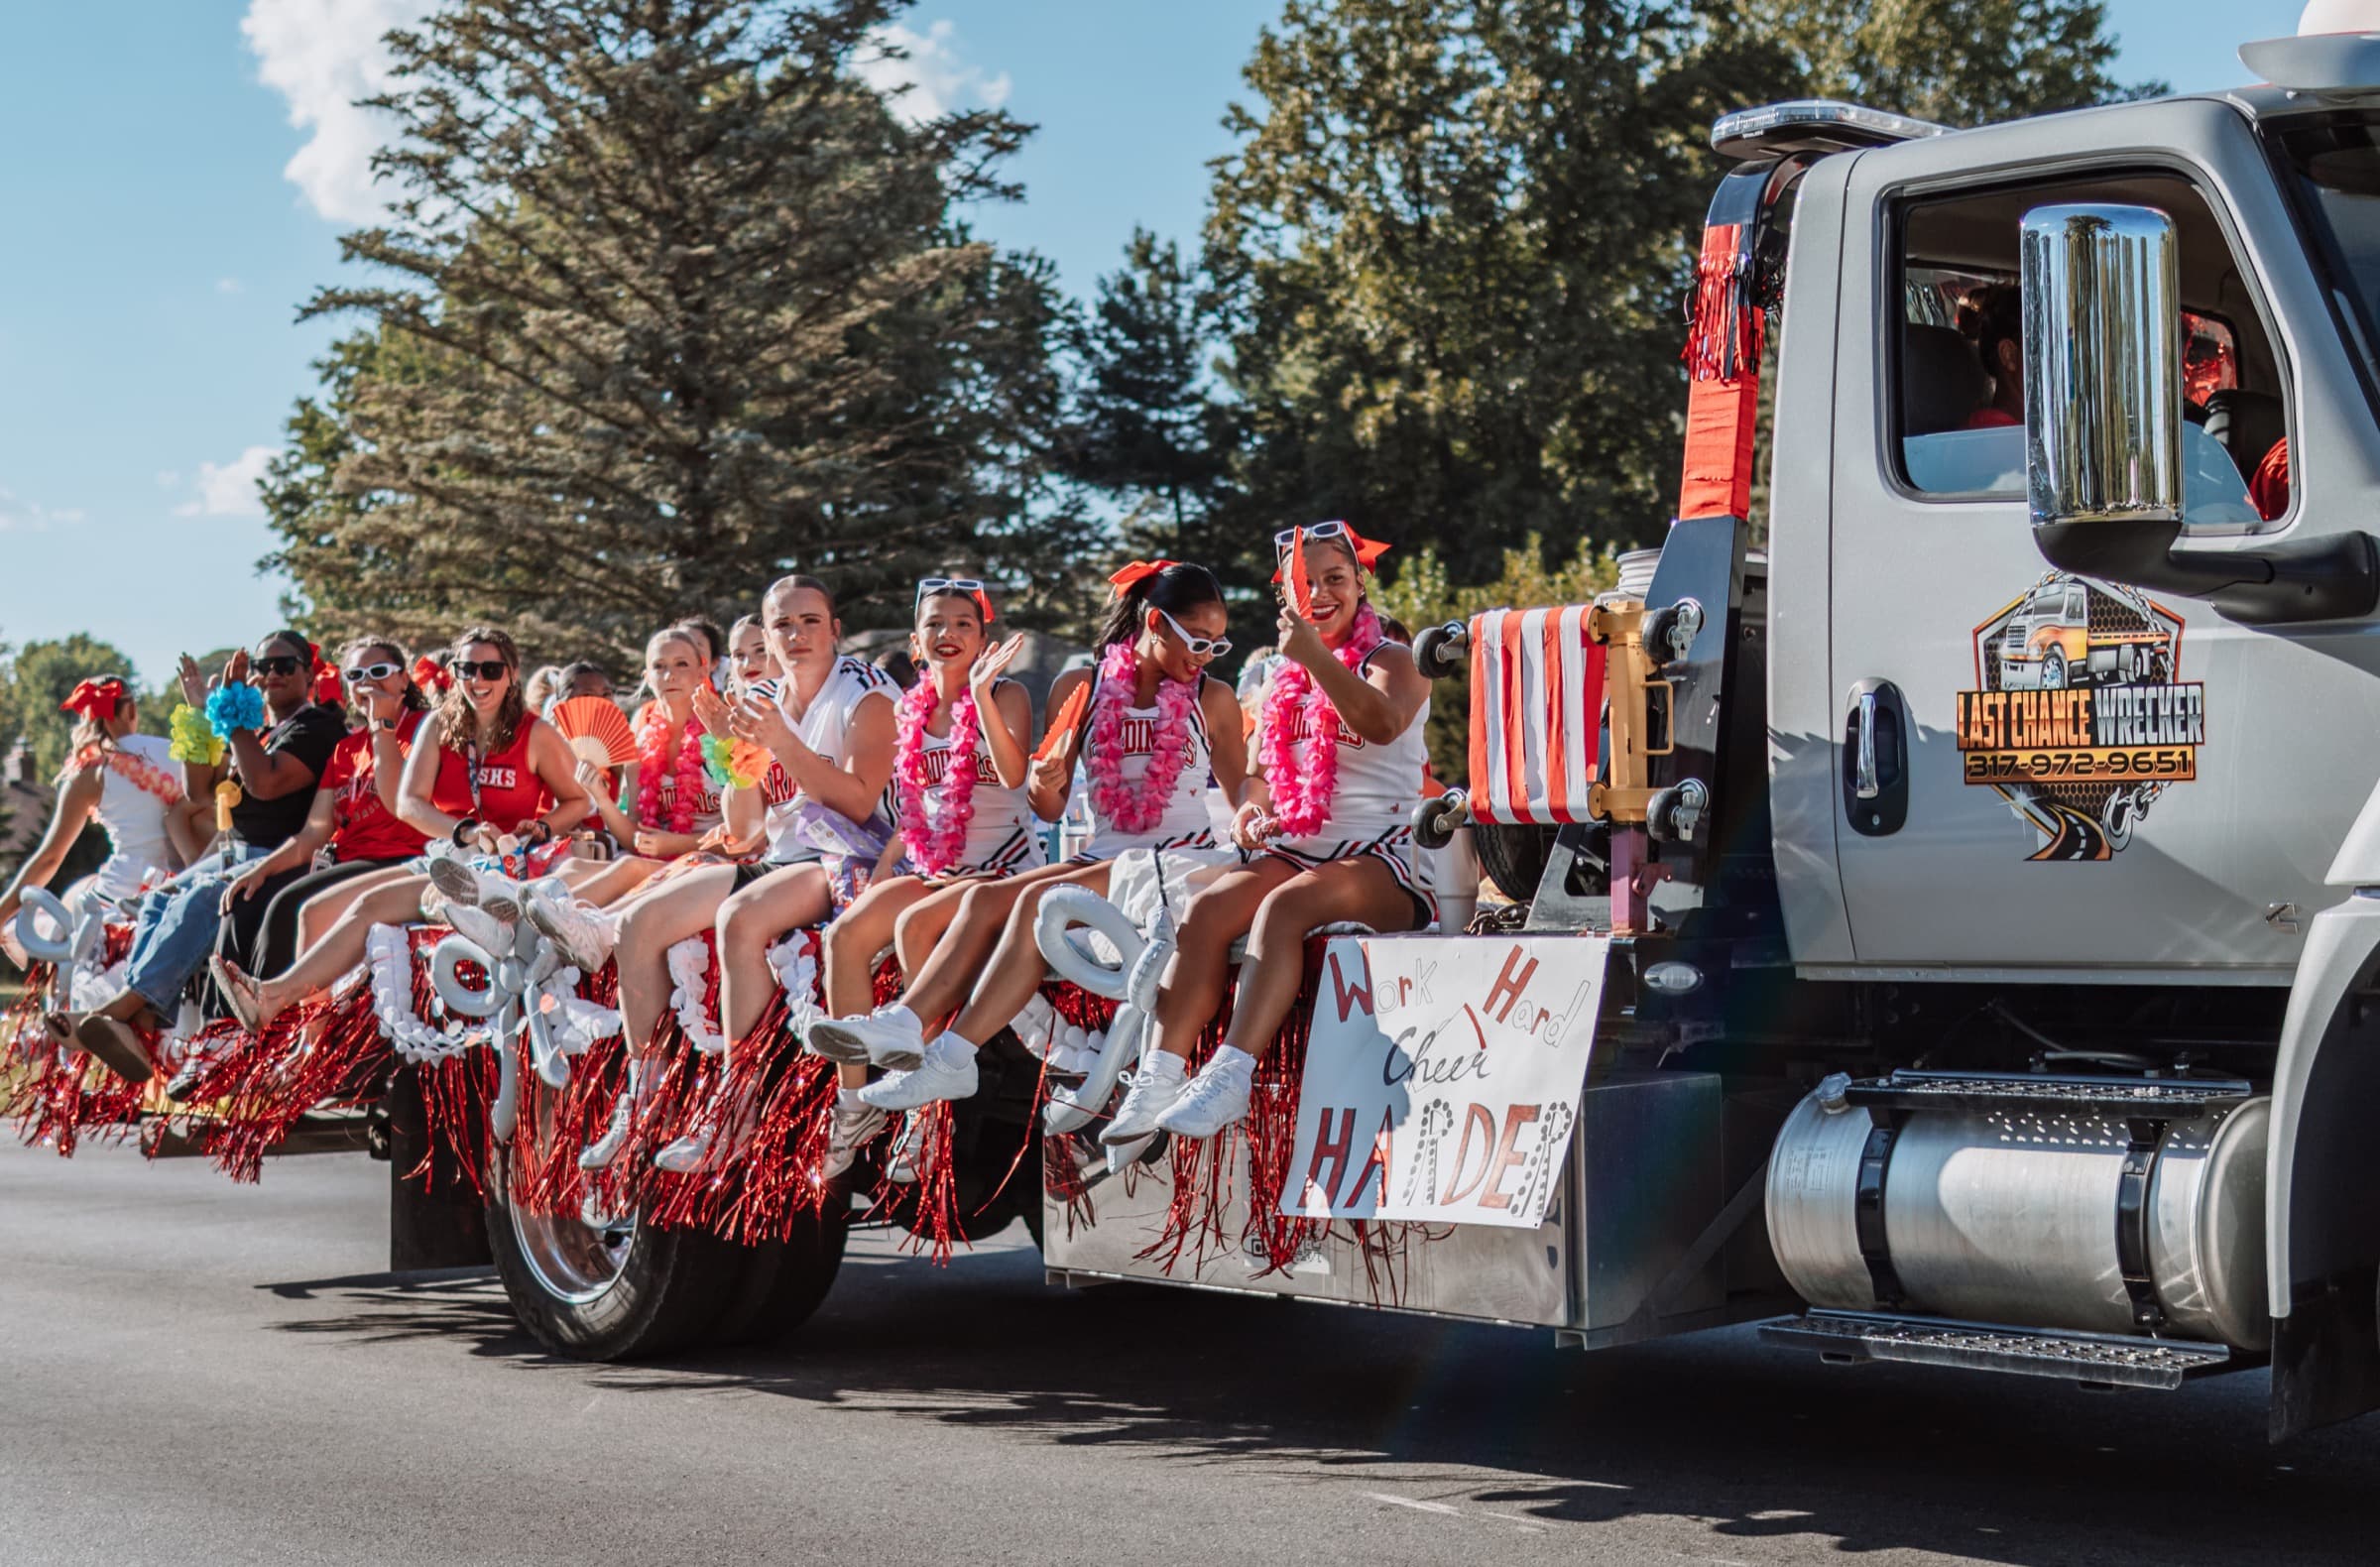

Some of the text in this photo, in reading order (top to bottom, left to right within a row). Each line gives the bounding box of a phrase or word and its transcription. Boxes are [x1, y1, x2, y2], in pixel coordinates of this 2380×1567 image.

[1958, 684, 2202, 748] LAST CHANCE WRECKER
[478, 767, 516, 788] SHS
[1967, 750, 2189, 779] 317-972-9651
[1483, 944, 1591, 1047] Hard
[1383, 1025, 1490, 1091] Cheer
[1296, 1098, 1573, 1218] HARDER
